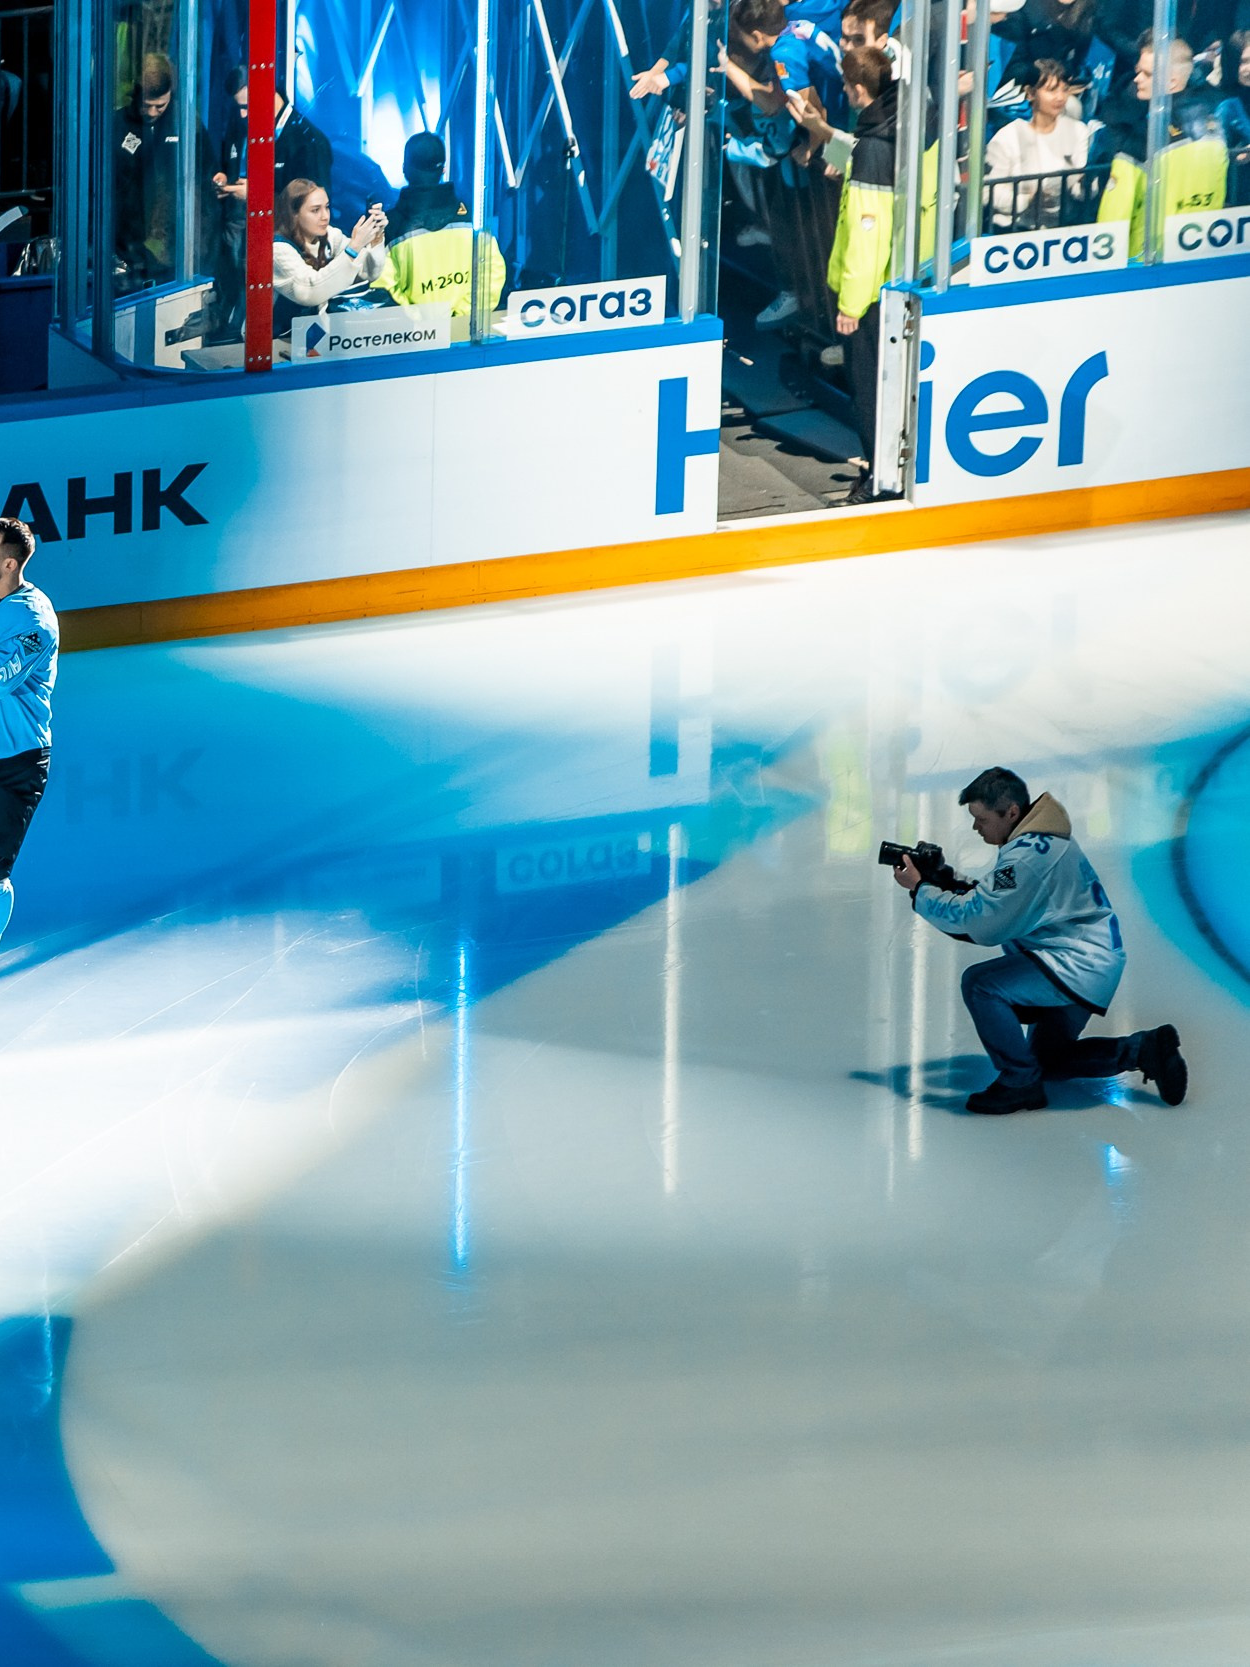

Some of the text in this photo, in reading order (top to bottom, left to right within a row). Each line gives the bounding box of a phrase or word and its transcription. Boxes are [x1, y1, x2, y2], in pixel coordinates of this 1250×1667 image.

[984, 232, 1115, 273] согаз
[520, 288, 652, 328] согаз
[329, 328, 436, 351] Ростелеком
